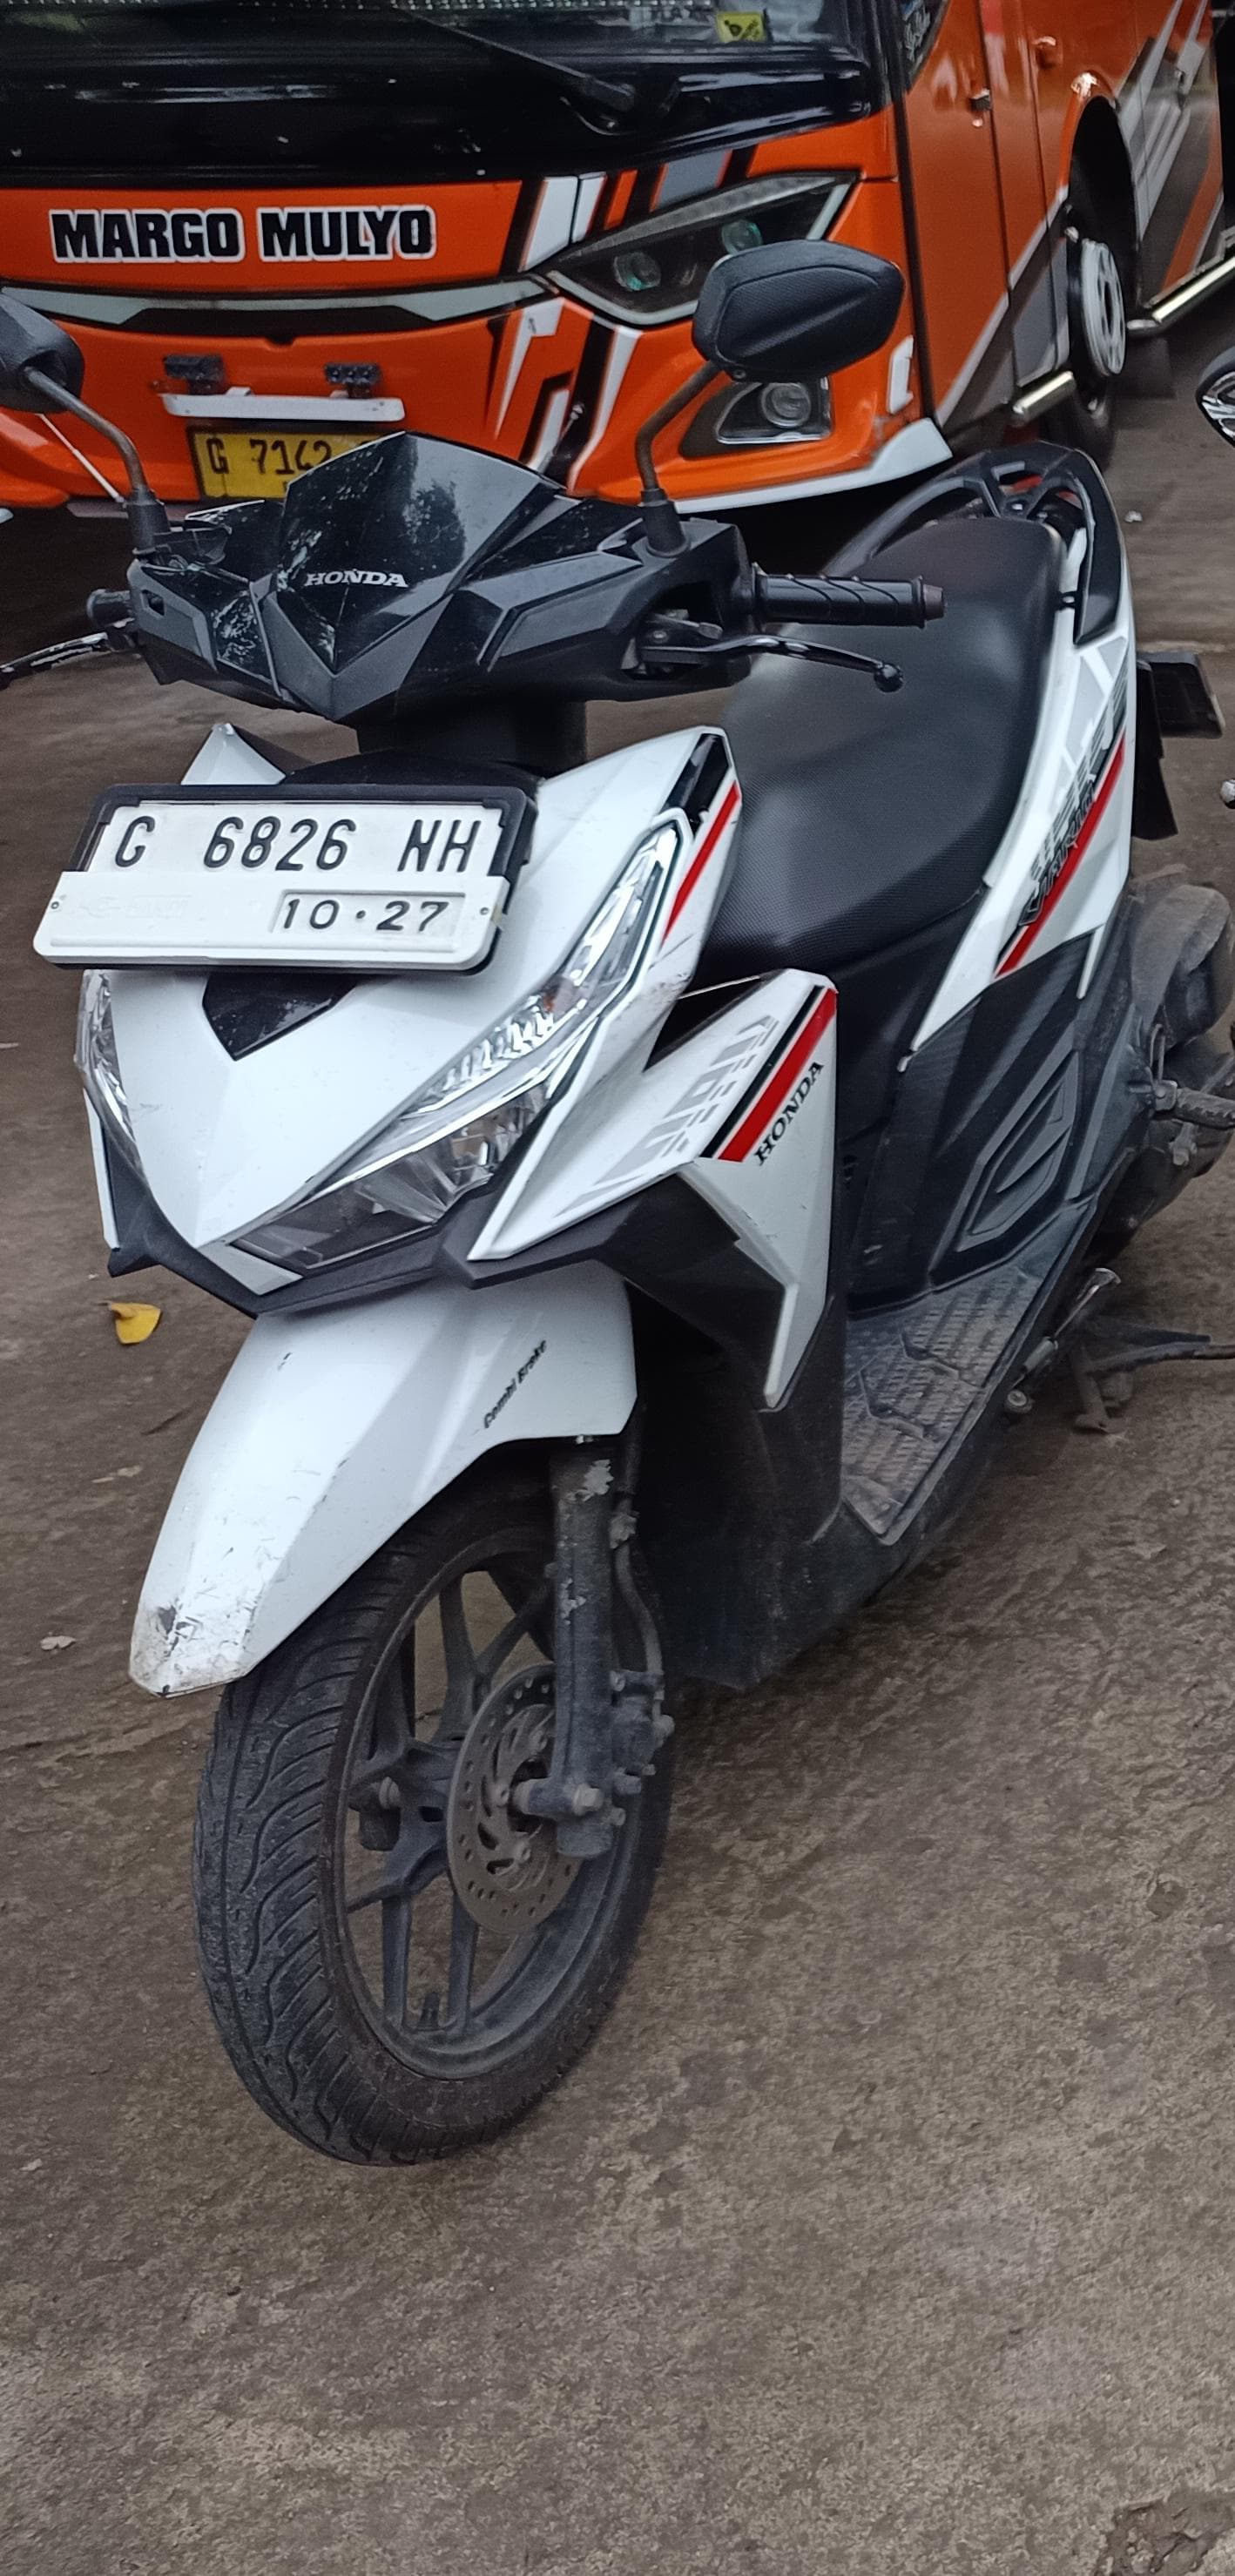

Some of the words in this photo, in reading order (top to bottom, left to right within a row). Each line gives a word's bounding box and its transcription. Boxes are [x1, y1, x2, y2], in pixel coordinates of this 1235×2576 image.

[51, 211, 244, 260] MARGO
[260, 208, 434, 259] MULYO
[206, 437, 230, 474] G
[304, 570, 409, 588] HONDA
[115, 815, 155, 867] G
[204, 816, 356, 871] 6826
[397, 819, 482, 873] NH
[754, 1061, 825, 1167] HONDA
